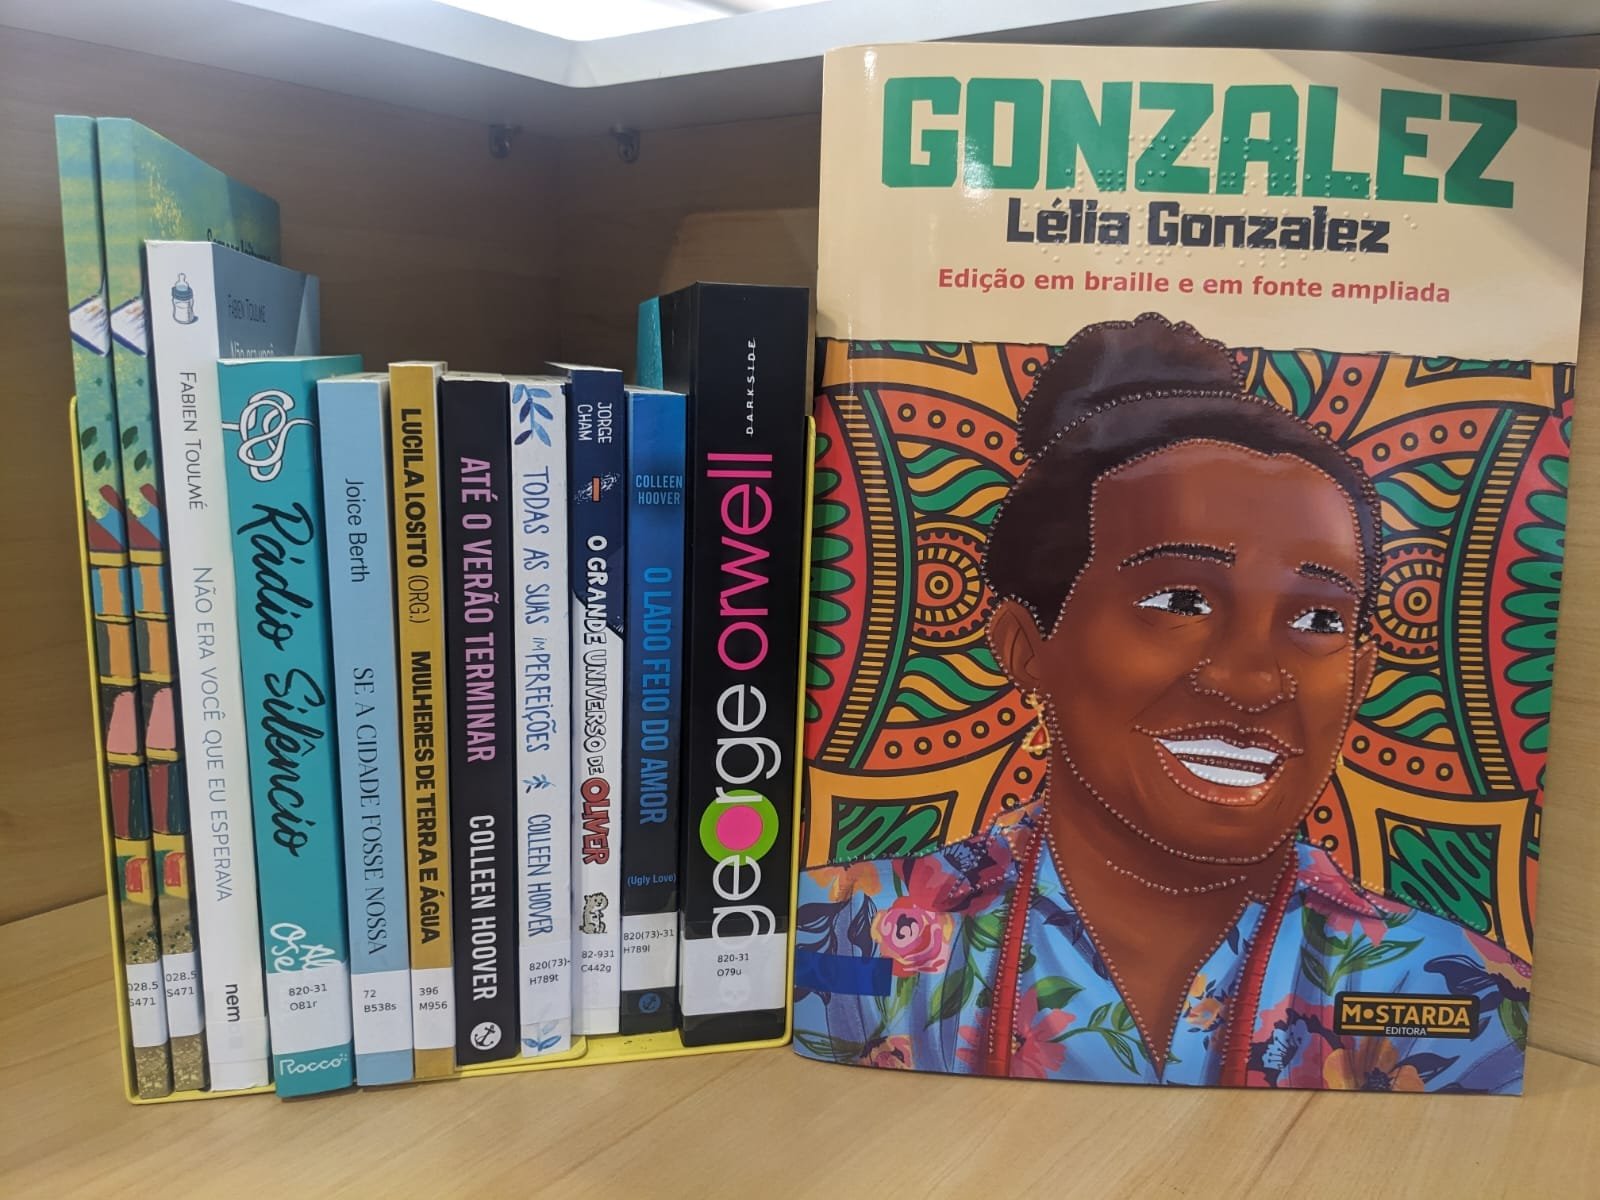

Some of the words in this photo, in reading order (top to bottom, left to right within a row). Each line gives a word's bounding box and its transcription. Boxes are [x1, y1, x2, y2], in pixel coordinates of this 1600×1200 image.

[881, 76, 1518, 209] GONZALEZ
[1006, 197, 1130, 246] Lélia
[1147, 200, 1391, 254] Gonzalez
[938, 267, 1025, 293] Edição
[1033, 272, 1075, 290] em
[1084, 270, 1169, 293] braille
[1178, 277, 1194, 294] e
[1202, 278, 1243, 295] em
[1252, 275, 1323, 298] fonte
[1331, 280, 1451, 304] ampliada
[179, 372, 198, 432] FABIEN
[746, 338, 757, 437] DARKSIDE
[577, 404, 593, 441] CHAM
[597, 401, 612, 444] JORGE
[401, 409, 424, 488] LUCILA
[184, 439, 208, 510] TOULMÉ
[460, 457, 498, 503] ATÉ
[635, 474, 683, 488] COLLEEN
[345, 478, 366, 526] Joice
[522, 465, 549, 535] TODAS
[638, 491, 681, 505] HOOVER
[405, 492, 428, 568] LOSITO
[462, 513, 492, 530] O
[587, 535, 608, 551] O
[237, 502, 314, 651] Rádio
[348, 532, 370, 583] Berth
[523, 548, 549, 571] AS
[644, 567, 672, 583] O
[706, 453, 773, 671] orwell
[193, 567, 216, 614] NÃO
[407, 575, 431, 624] (ORG.)
[463, 539, 499, 624] VERÃO
[525, 583, 550, 625] SUAS
[583, 557, 609, 645] GRANDE
[197, 622, 215, 659] ERA
[643, 591, 672, 648] LADO
[200, 666, 226, 721] VOCÊ
[353, 667, 375, 695] SE
[465, 632, 496, 763] TERMINAR
[583, 650, 607, 753] UNIVERSO
[641, 659, 671, 713] FEIO
[355, 702, 376, 718] A
[411, 651, 434, 762] MULHERES
[201, 729, 225, 770] QUE
[641, 719, 670, 753] DO
[261, 668, 326, 857] Silêncio
[356, 724, 381, 808] CIDADE
[415, 765, 435, 790] DE
[586, 756, 605, 775] DE
[208, 778, 226, 802] EU
[639, 758, 669, 825] AMOR
[416, 793, 438, 865] TERRA
[580, 777, 611, 865] OLIVER
[210, 810, 233, 902] ESPERAVA
[360, 814, 384, 881] FOSSE
[469, 814, 496, 910] COLLEEN
[527, 813, 553, 877] COLLEEN
[419, 867, 438, 881] E
[627, 874, 651, 887] (Ugly
[652, 873, 677, 884] Love)
[365, 887, 388, 956] NOSSA
[420, 886, 445, 944] ÁGUA
[528, 882, 553, 937] HOOVER
[581, 950, 615, 959] 82-931
[623, 929, 675, 941] 820(73)-31
[717, 953, 749, 963] 820-31
[166, 969, 198, 982] 028.5
[471, 916, 498, 1001] HOOVER
[529, 974, 559, 985] H789t
[580, 963, 612, 973] C442g
[167, 986, 195, 998] S471
[225, 984, 241, 1022] nem
[288, 983, 328, 996] 820-31
[363, 989, 377, 999] 72
[363, 1003, 397, 1013] B538s
[418, 987, 439, 996] 396
[418, 1001, 448, 1011] M956
[1385, 1026, 1427, 1036] EDITORA
[280, 1057, 343, 1076] Rocco
